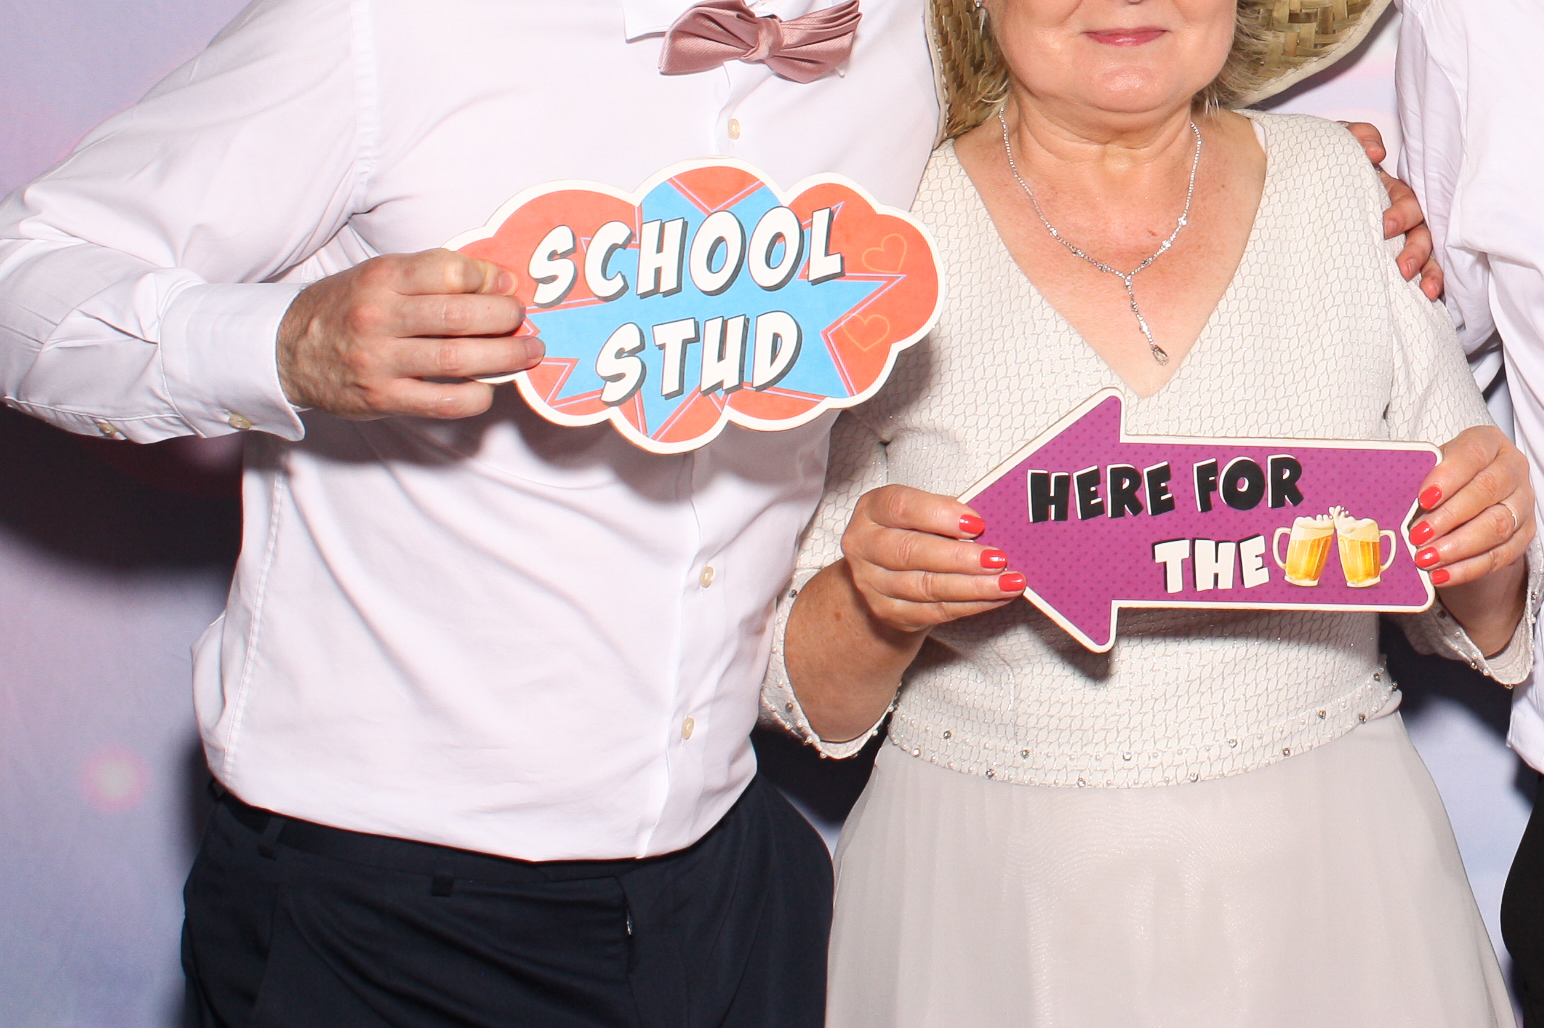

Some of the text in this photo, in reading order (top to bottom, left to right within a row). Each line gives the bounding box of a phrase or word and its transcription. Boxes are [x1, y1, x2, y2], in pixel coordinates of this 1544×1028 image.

[528, 205, 844, 308] SCHOOL
[594, 310, 802, 405] STUD
[1026, 453, 1304, 524] HERE FOR
[1152, 534, 1270, 593] THE
